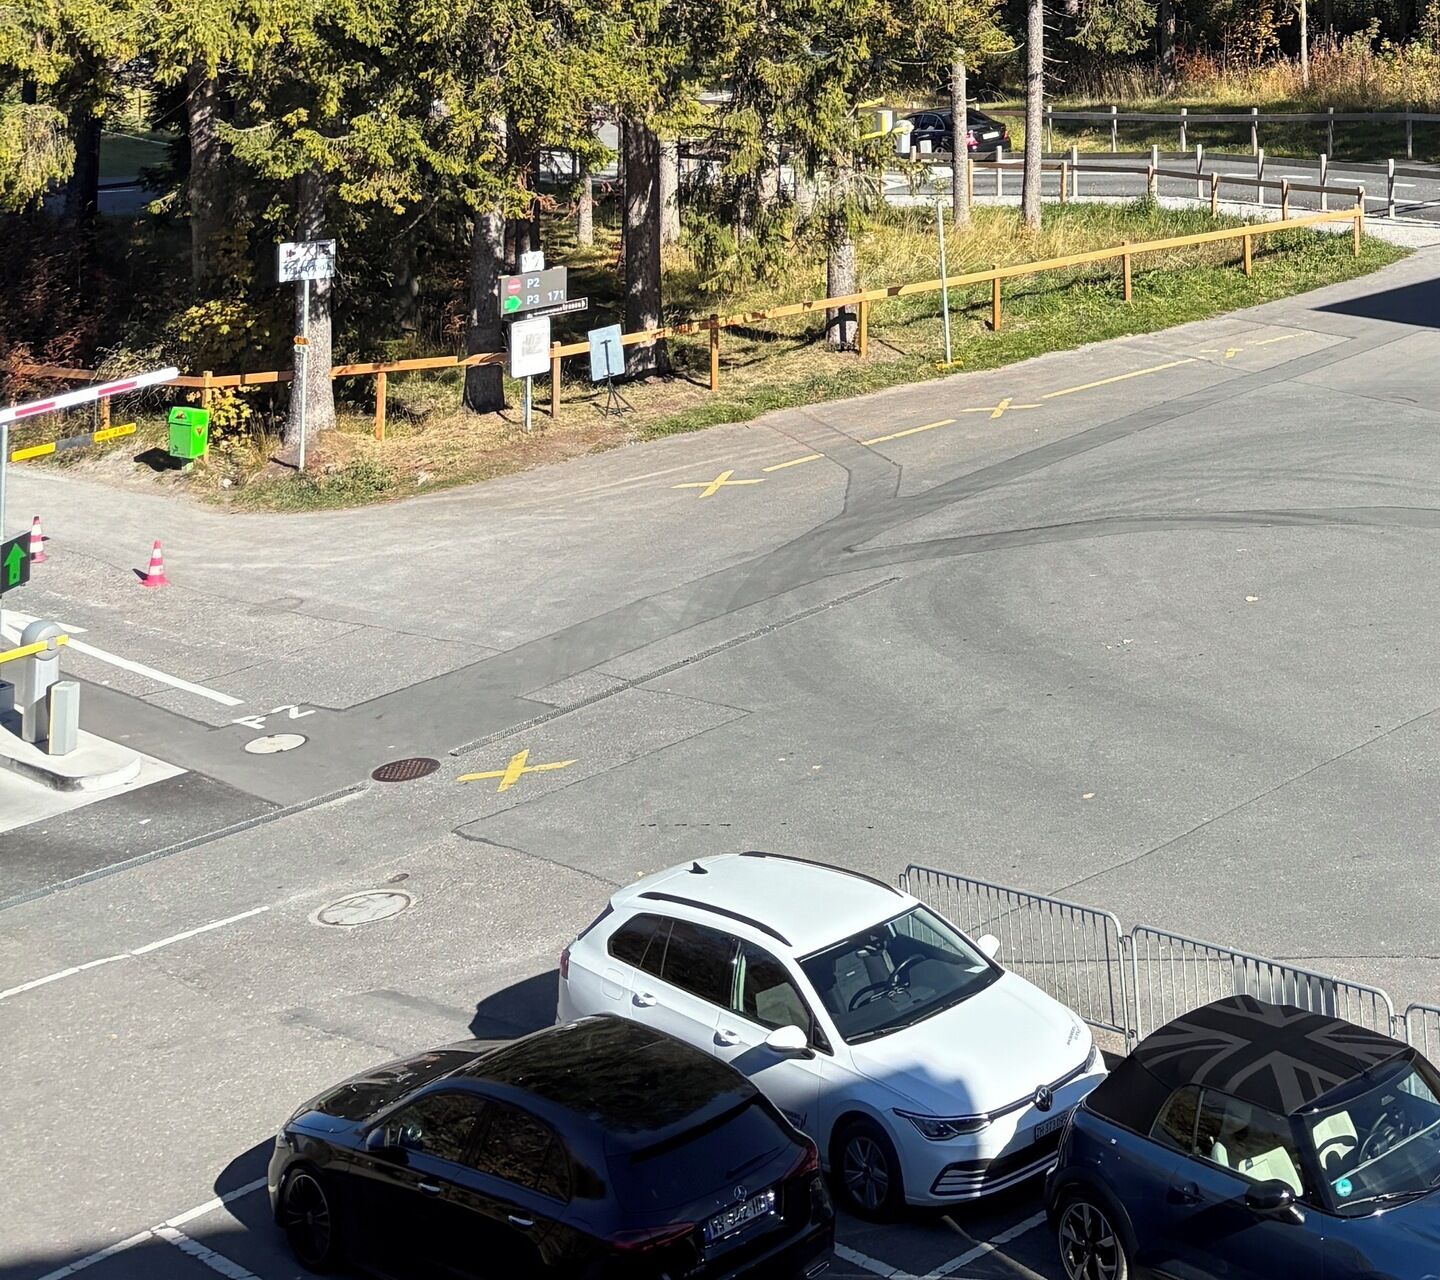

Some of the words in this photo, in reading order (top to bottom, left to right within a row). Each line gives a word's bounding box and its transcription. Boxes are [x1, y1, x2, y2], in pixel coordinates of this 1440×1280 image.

[527, 278, 540, 289] P2
[527, 295, 540, 305] P3
[548, 290, 565, 301] 171
[232, 704, 316, 730] P2
